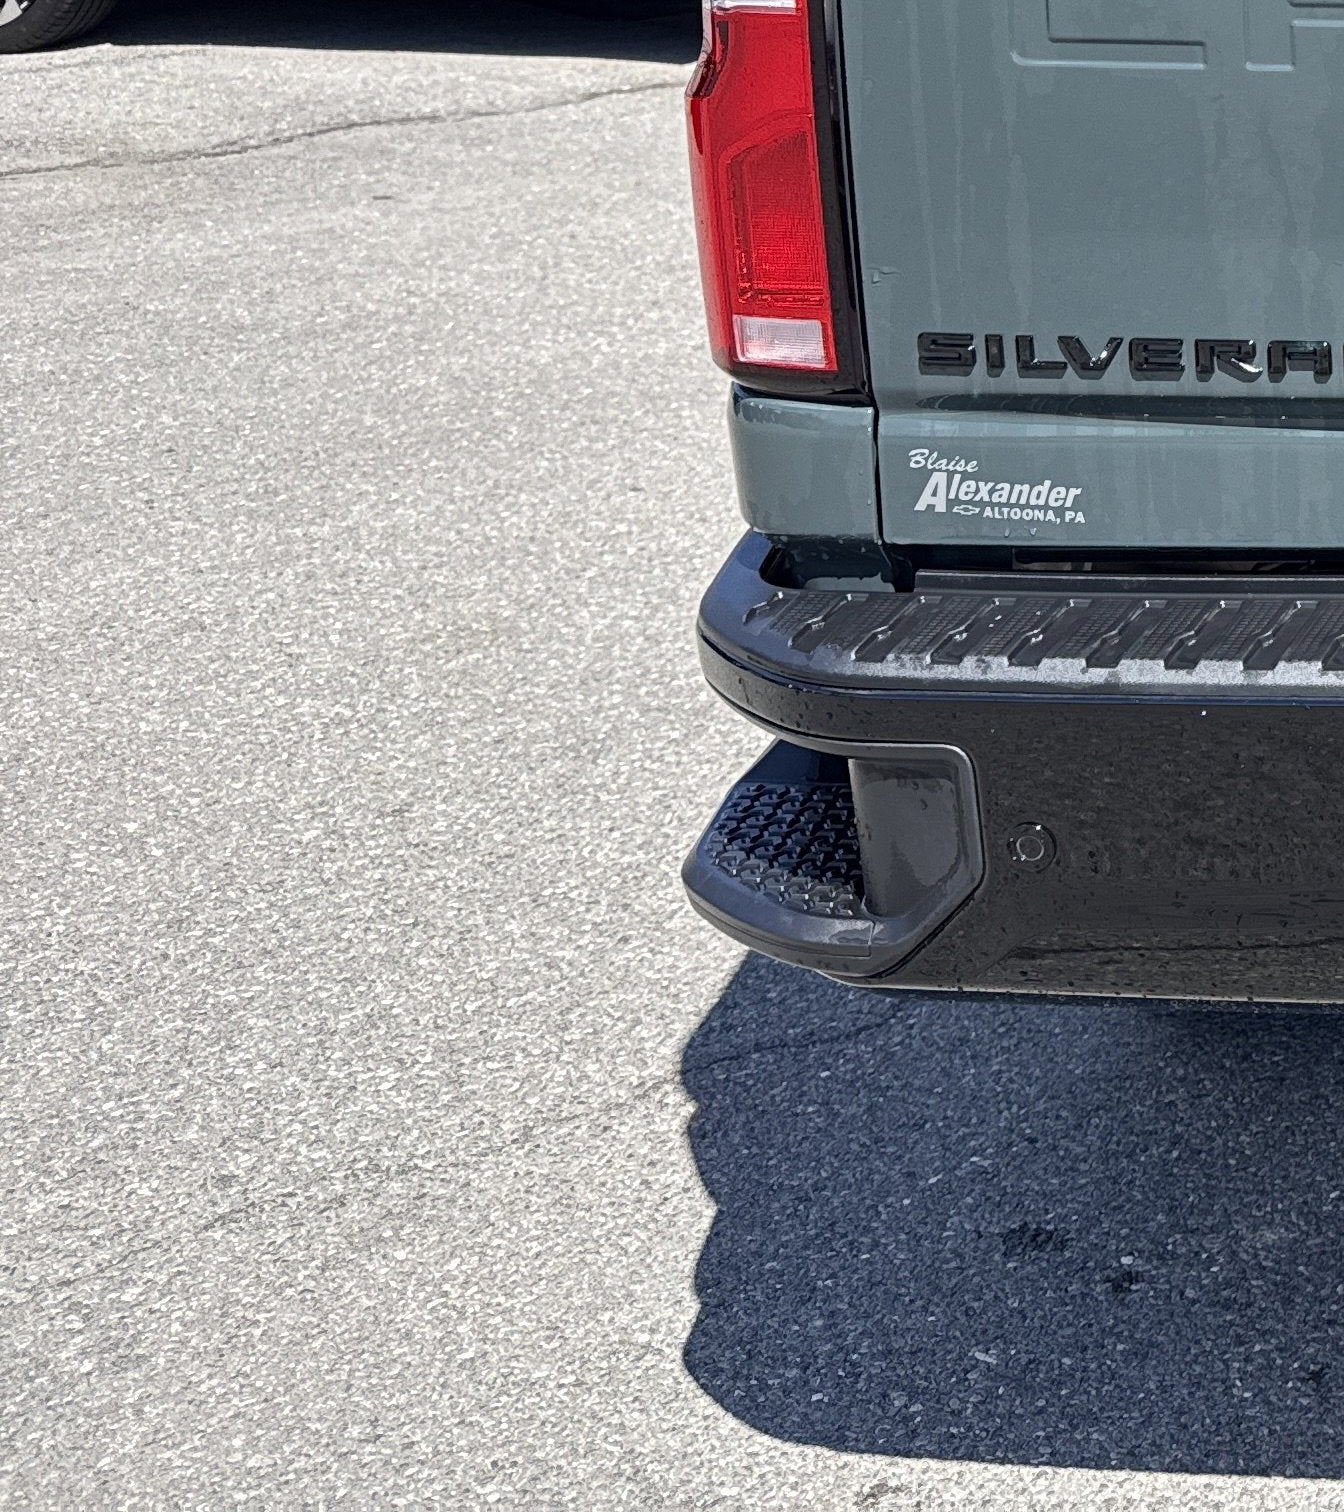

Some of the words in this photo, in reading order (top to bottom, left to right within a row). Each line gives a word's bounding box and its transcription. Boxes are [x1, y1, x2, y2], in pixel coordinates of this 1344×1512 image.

[908, 448, 979, 473] Blaise
[913, 471, 1083, 513] Alexander
[982, 506, 1061, 525] ALTOONA,
[1064, 510, 1086, 524] PA
